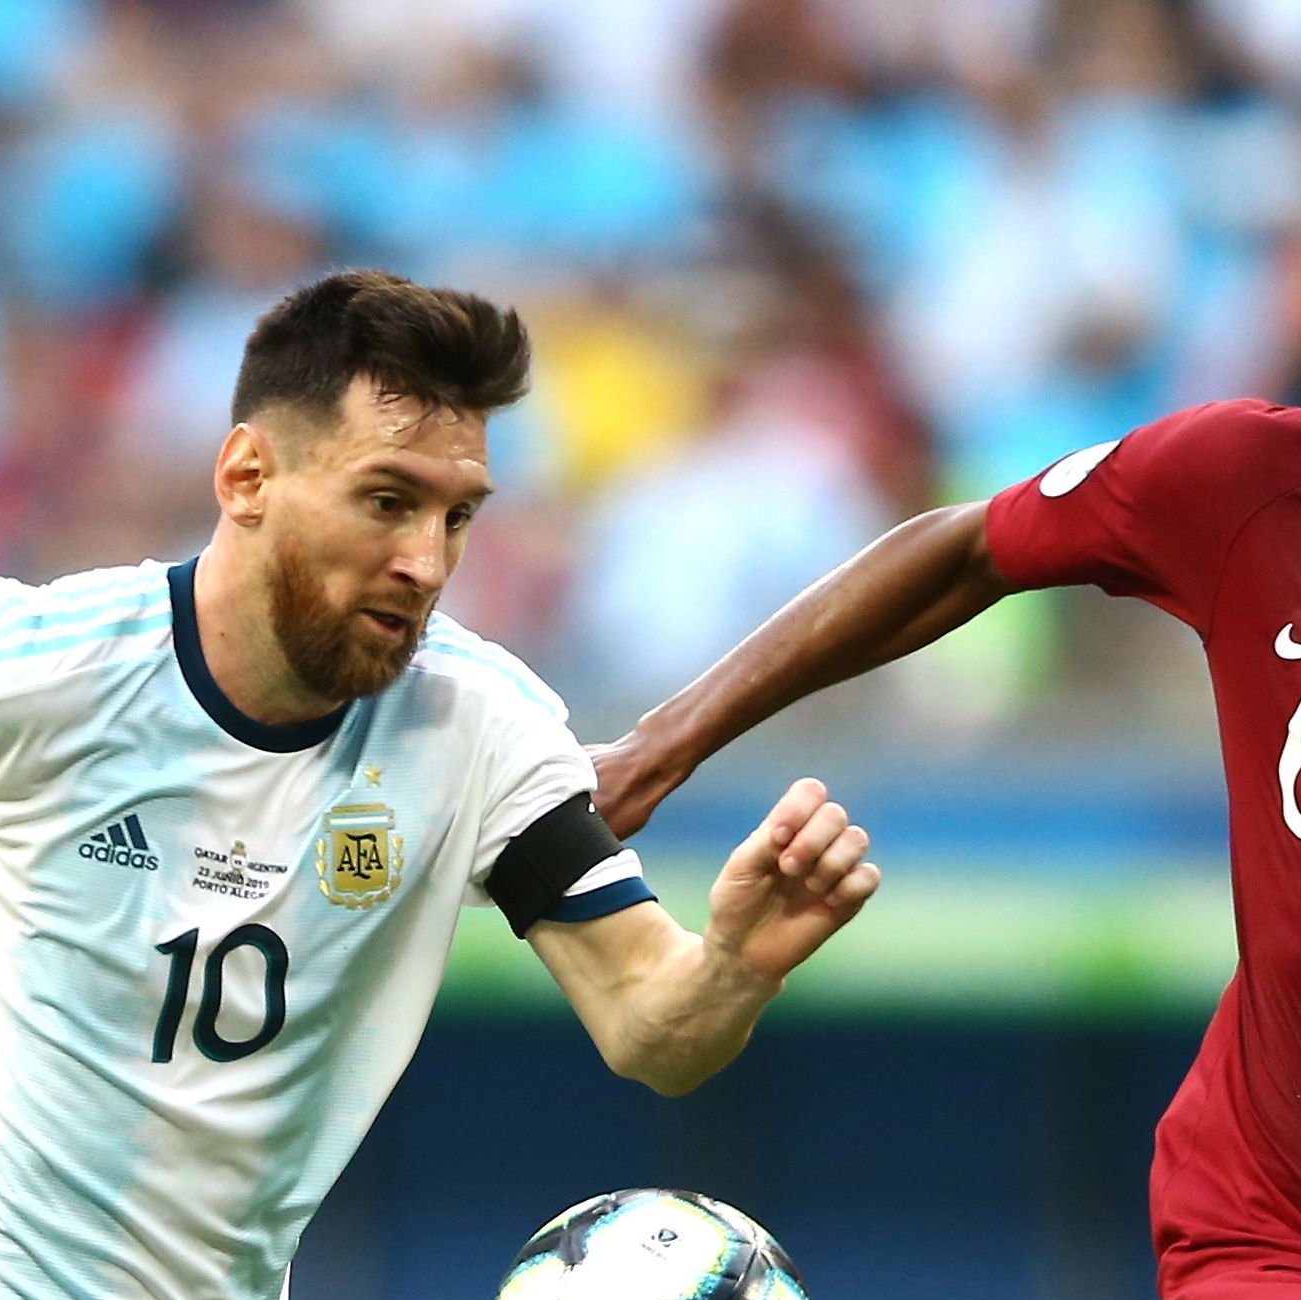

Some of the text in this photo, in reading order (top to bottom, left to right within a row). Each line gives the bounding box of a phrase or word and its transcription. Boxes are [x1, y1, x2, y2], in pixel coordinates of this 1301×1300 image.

[79, 844, 159, 871] adidas
[194, 847, 227, 864] QATAR
[337, 833, 384, 879] AFA
[193, 878, 227, 894] PORTO
[198, 867, 210, 877] 23
[245, 877, 269, 889] 2019
[152, 923, 288, 1063] 10
